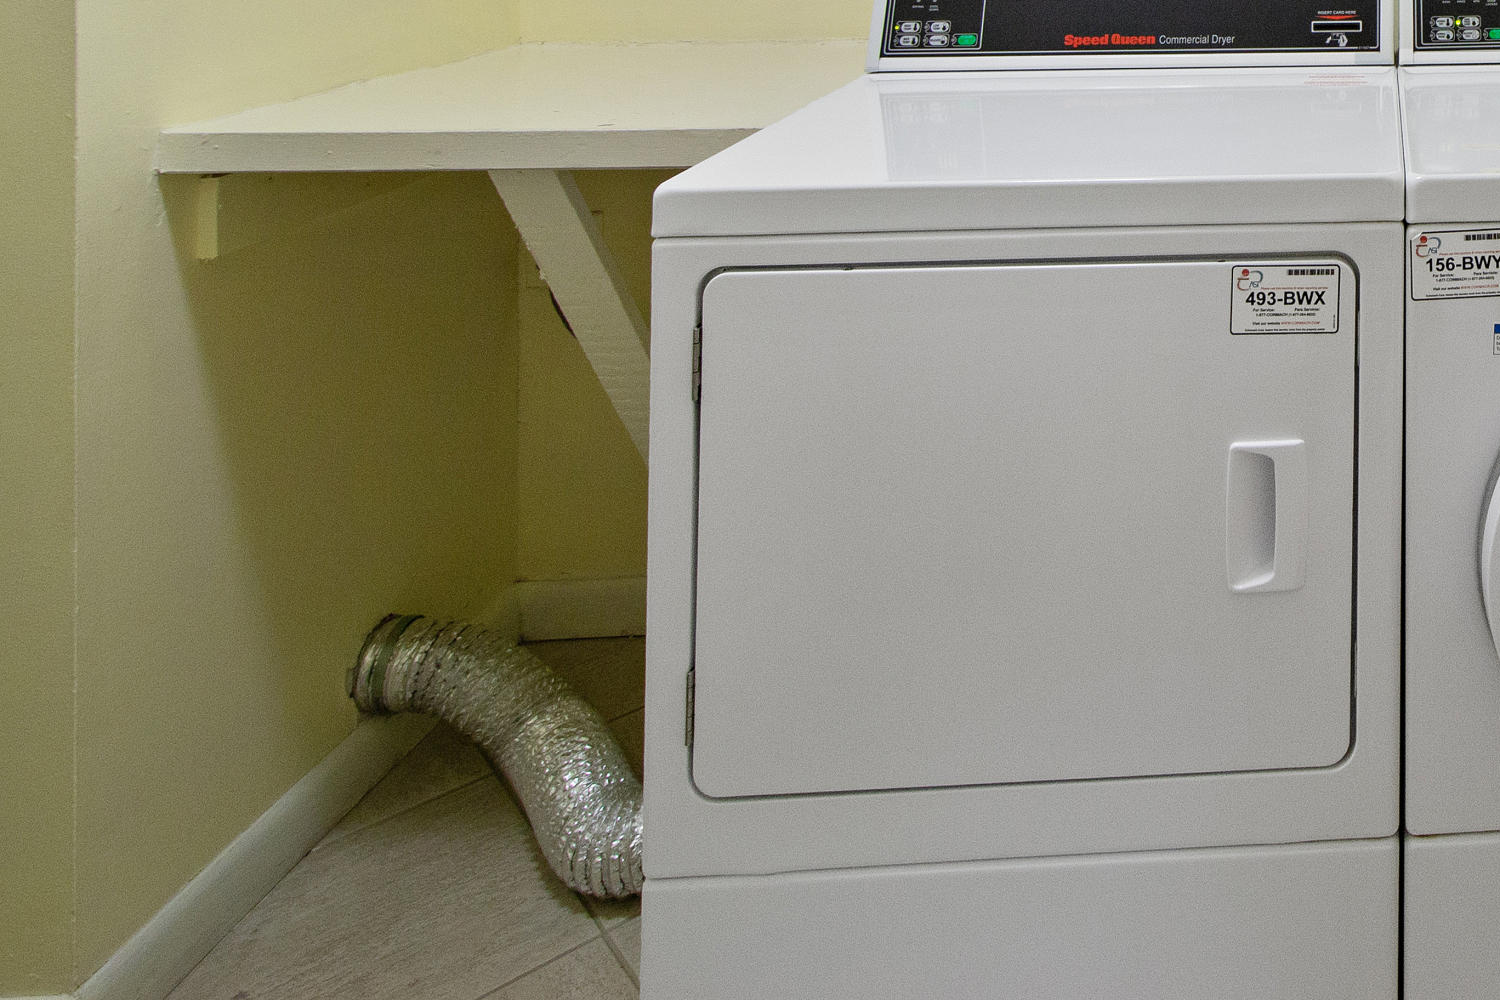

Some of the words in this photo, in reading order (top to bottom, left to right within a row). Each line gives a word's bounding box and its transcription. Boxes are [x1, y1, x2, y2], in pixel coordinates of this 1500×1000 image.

[1064, 34, 1109, 47] Speed
[1111, 35, 1156, 45] Queen
[1159, 35, 1210, 44] Commercial
[1212, 35, 1235, 46] Dryer
[1246, 291, 1326, 305] 493-BWX
